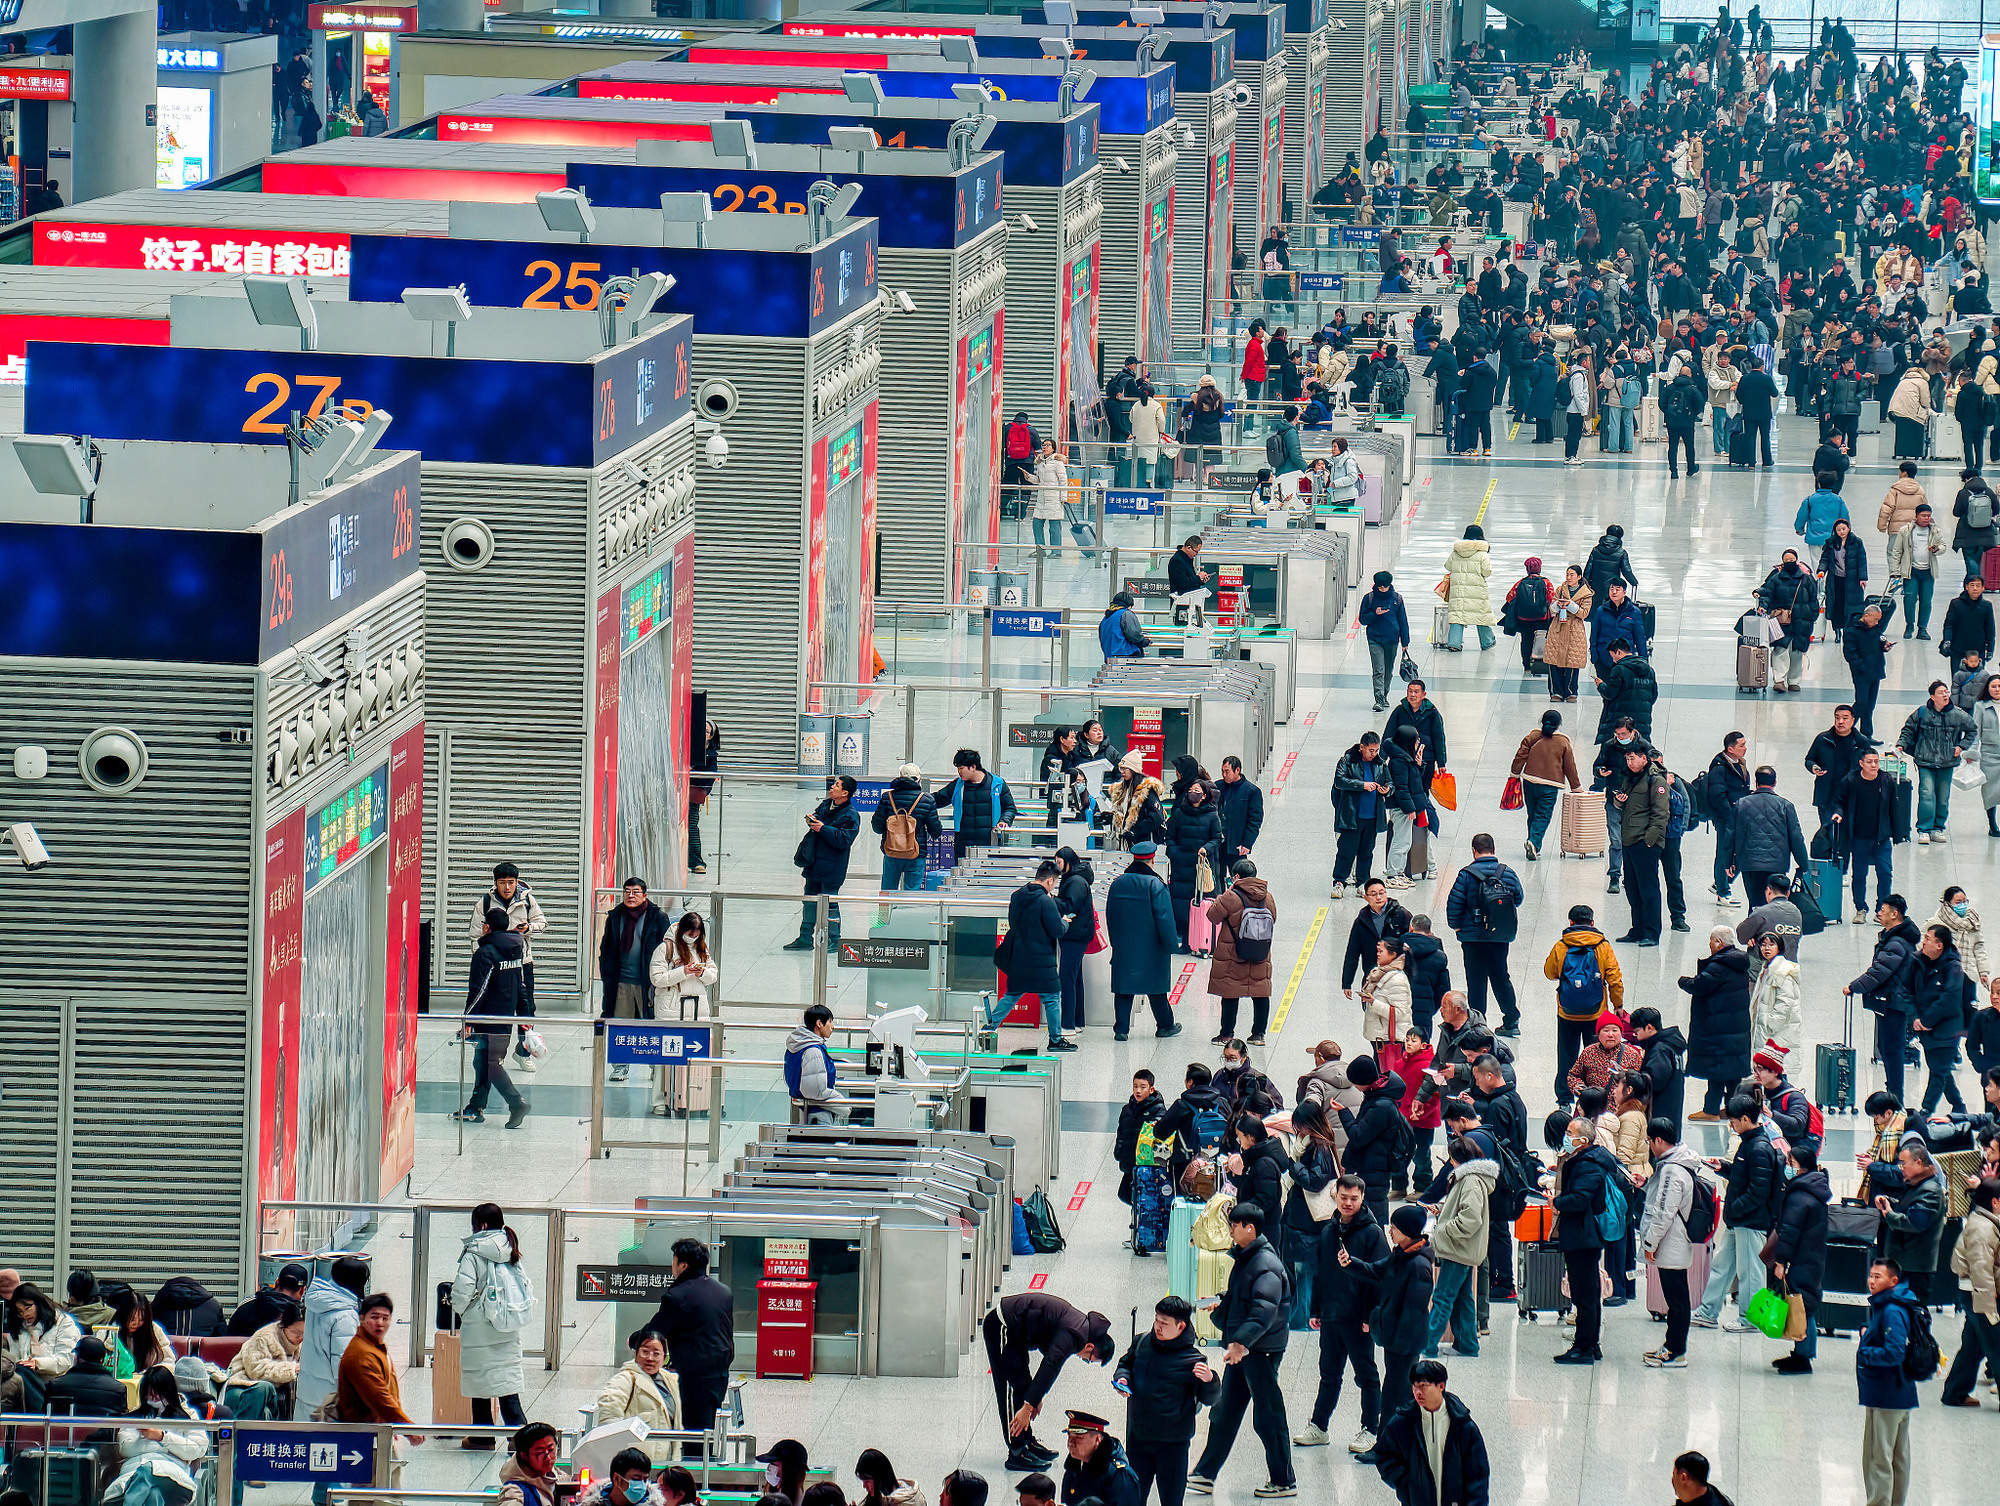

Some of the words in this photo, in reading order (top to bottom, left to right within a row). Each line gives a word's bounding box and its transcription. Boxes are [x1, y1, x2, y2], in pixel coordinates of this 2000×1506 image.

[523, 260, 630, 309] 25
[600, 378, 616, 442] 27B
[392, 484, 418, 561] 28B
[269, 548, 294, 631] 29B
[853, 789, 879, 798] 捷换乘
[864, 946, 925, 958] 请勿翻越栏杆
[615, 1035, 660, 1046] 便捷换乘
[610, 1273, 674, 1288] 请勿翻越栏
[619, 1289, 646, 1297] Crossing
[246, 1442, 307, 1458] 便捷换乘
[269, 1459, 306, 1470] Transfer
